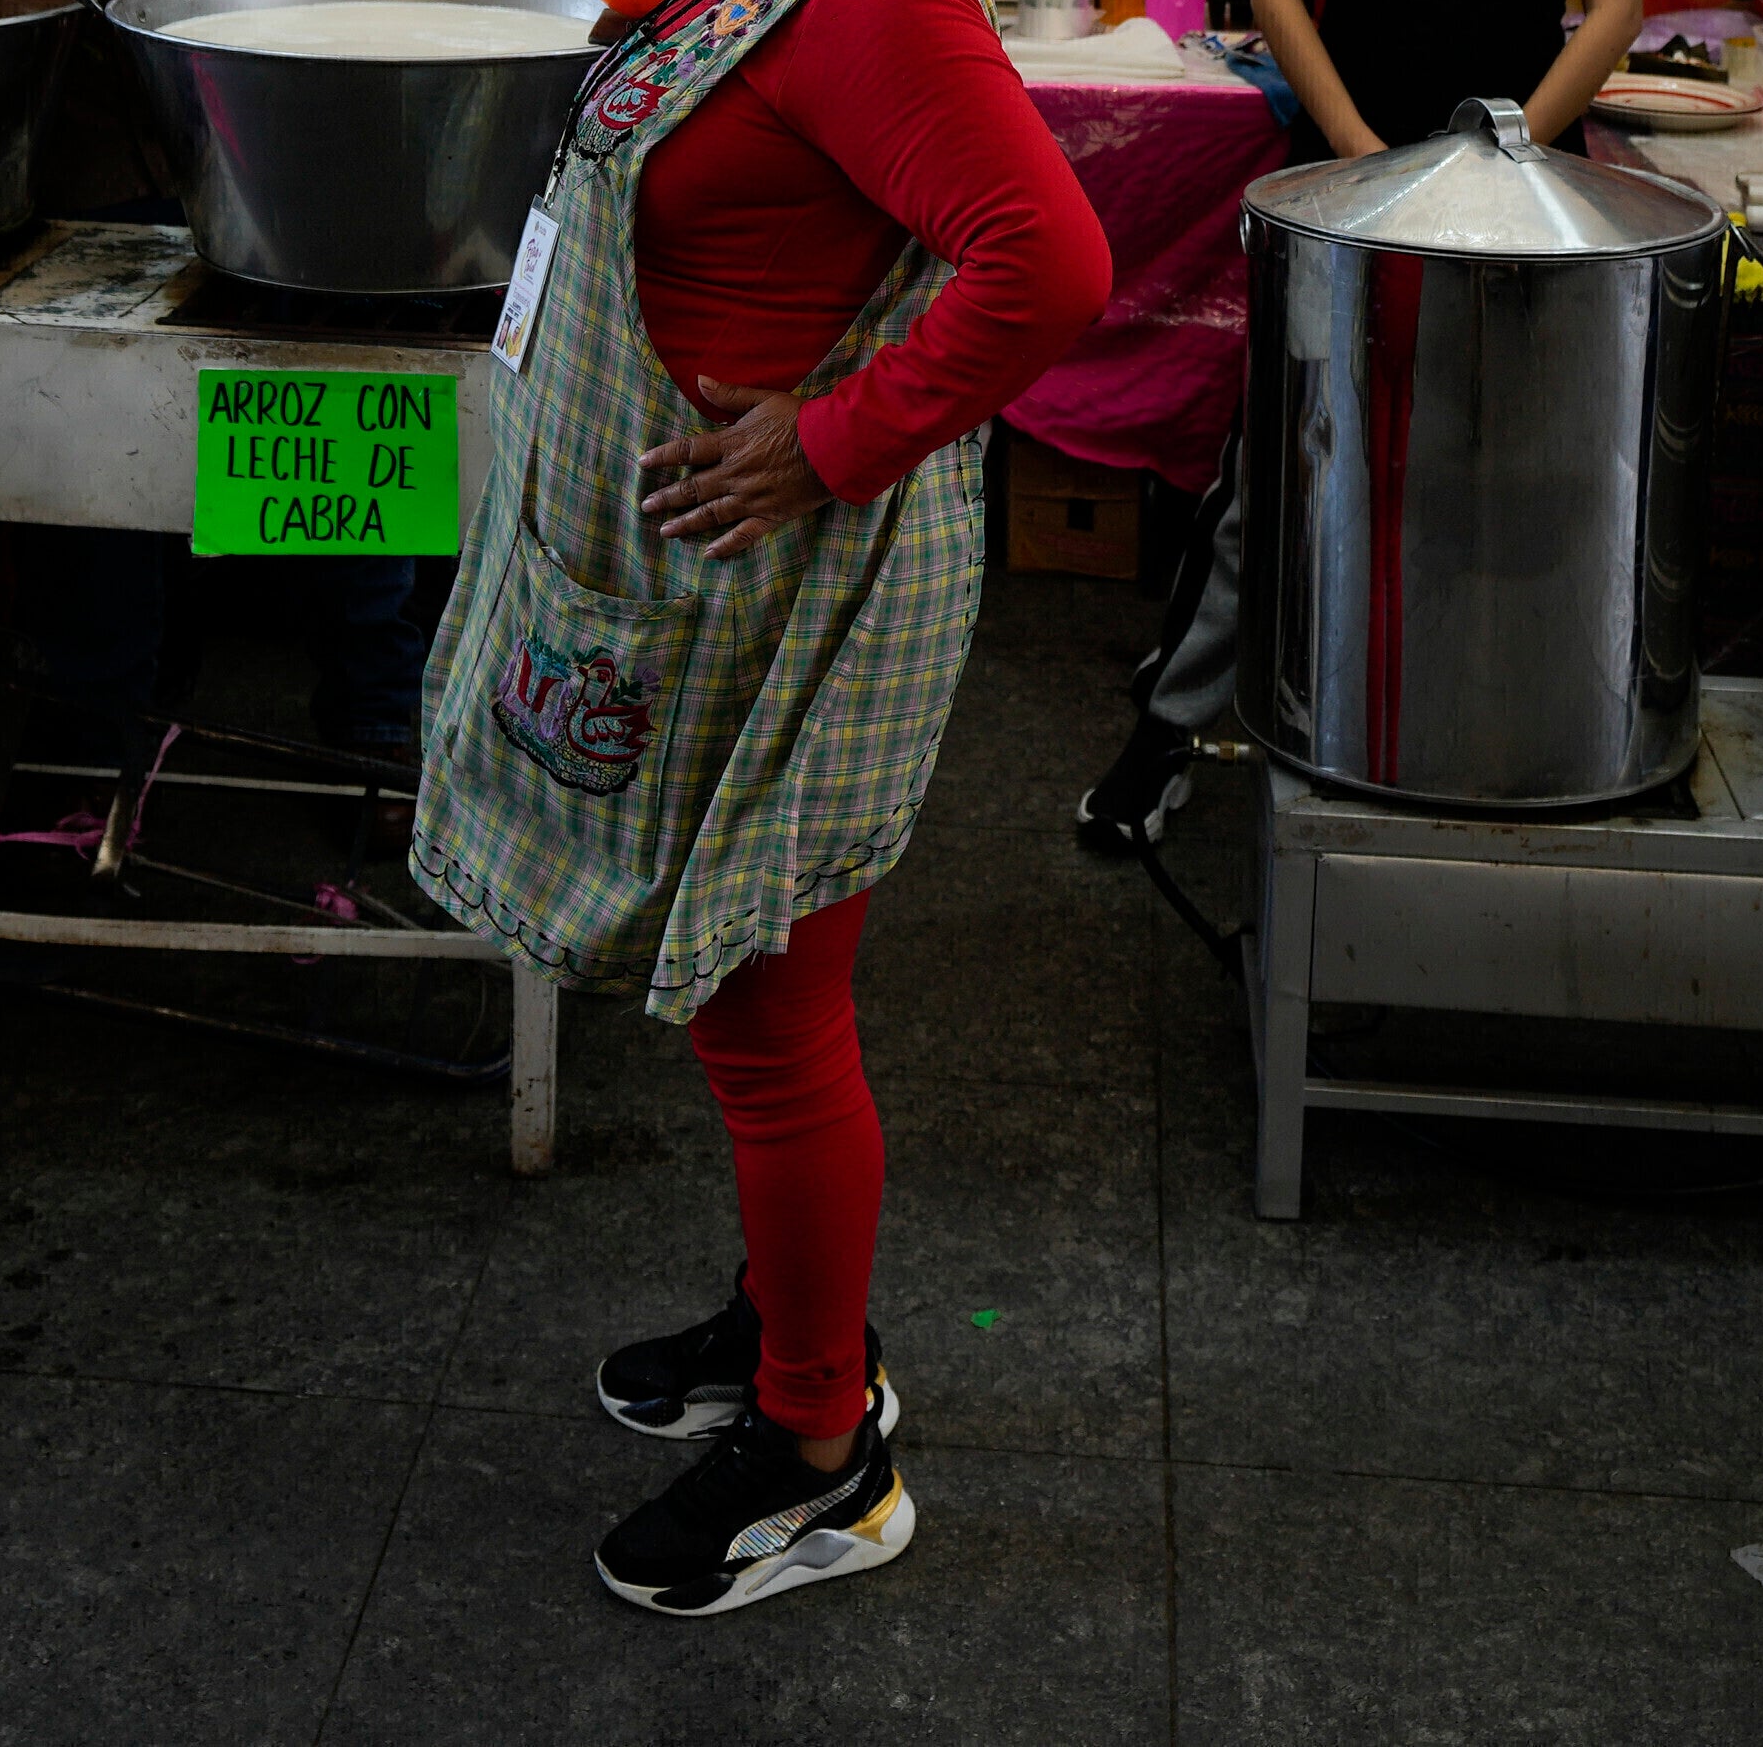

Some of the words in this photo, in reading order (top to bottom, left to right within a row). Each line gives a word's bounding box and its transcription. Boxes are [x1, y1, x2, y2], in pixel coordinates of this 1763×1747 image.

[208, 380, 326, 428] ARROZ
[356, 383, 432, 432] CON
[226, 436, 337, 485] LECHE
[369, 443, 418, 491] DE
[258, 495, 386, 544] CABRA
